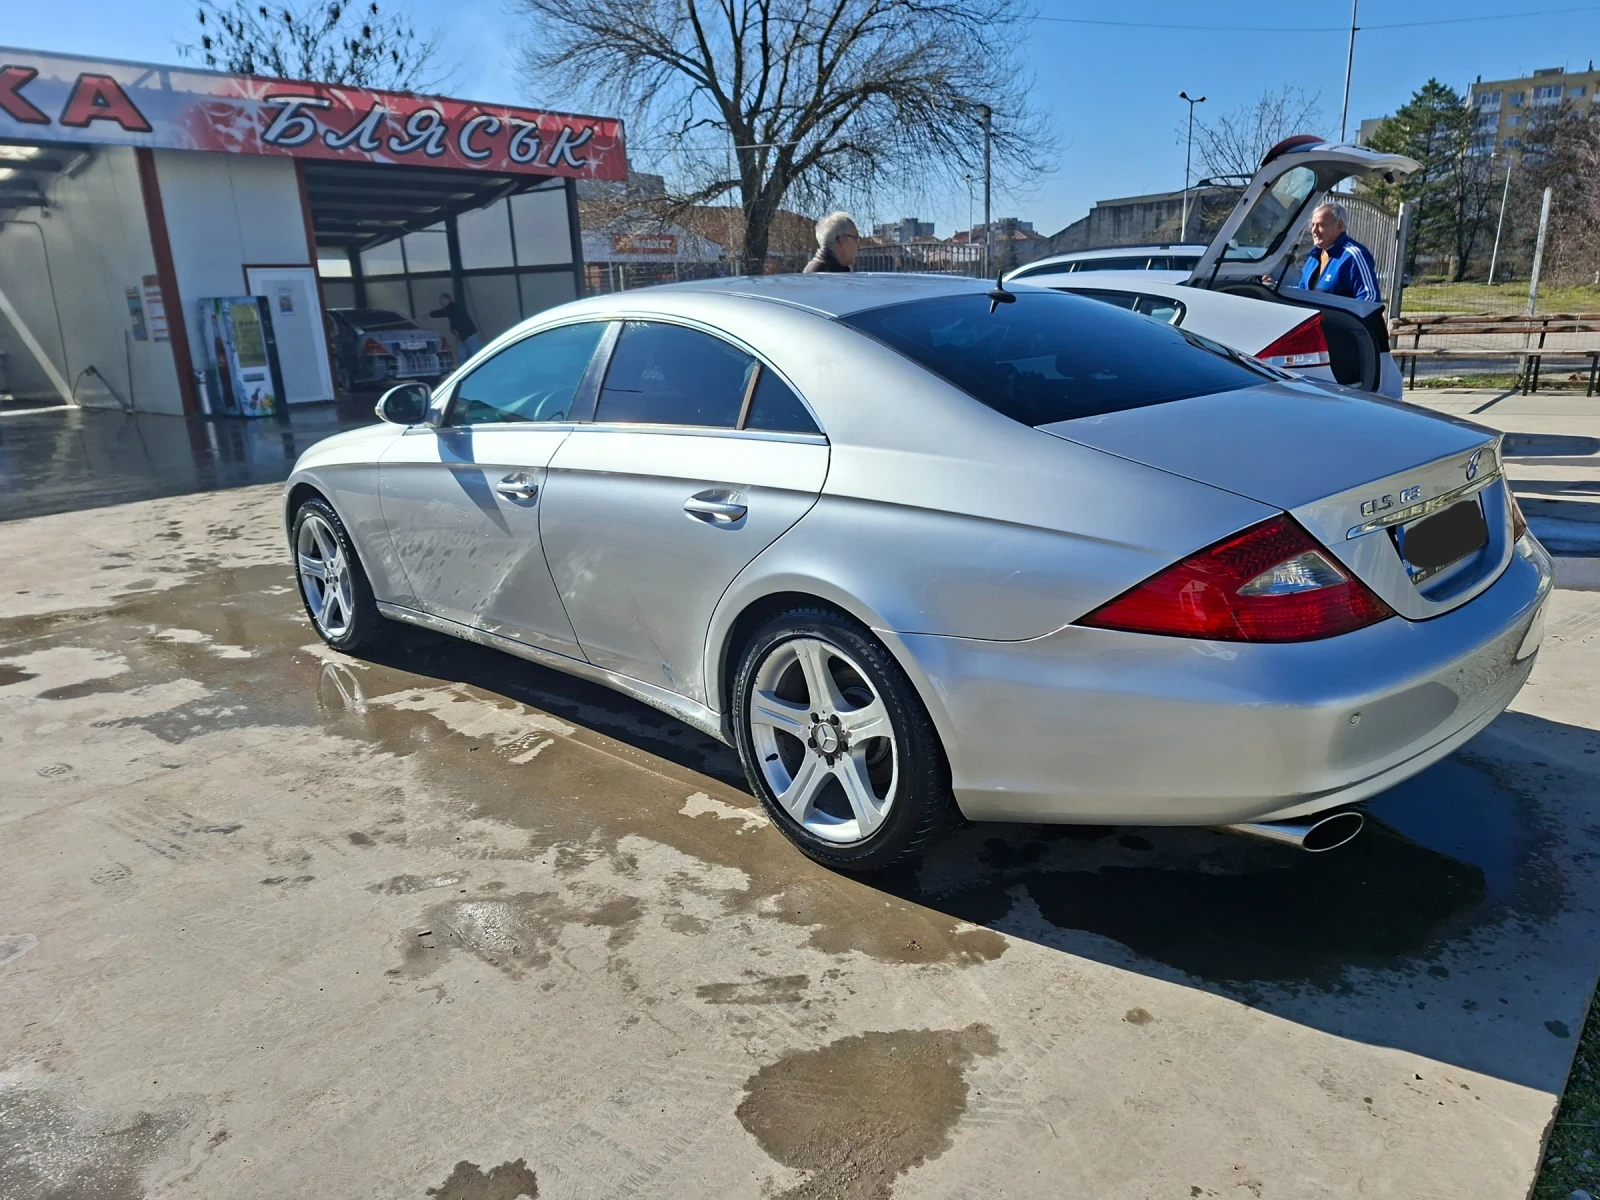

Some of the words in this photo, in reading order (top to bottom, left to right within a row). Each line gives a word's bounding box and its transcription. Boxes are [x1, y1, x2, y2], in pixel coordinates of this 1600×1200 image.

[261, 94, 595, 169] БЛЯСЪК
[1361, 494, 1394, 517] CLS
[1400, 485, 1420, 504] 63
